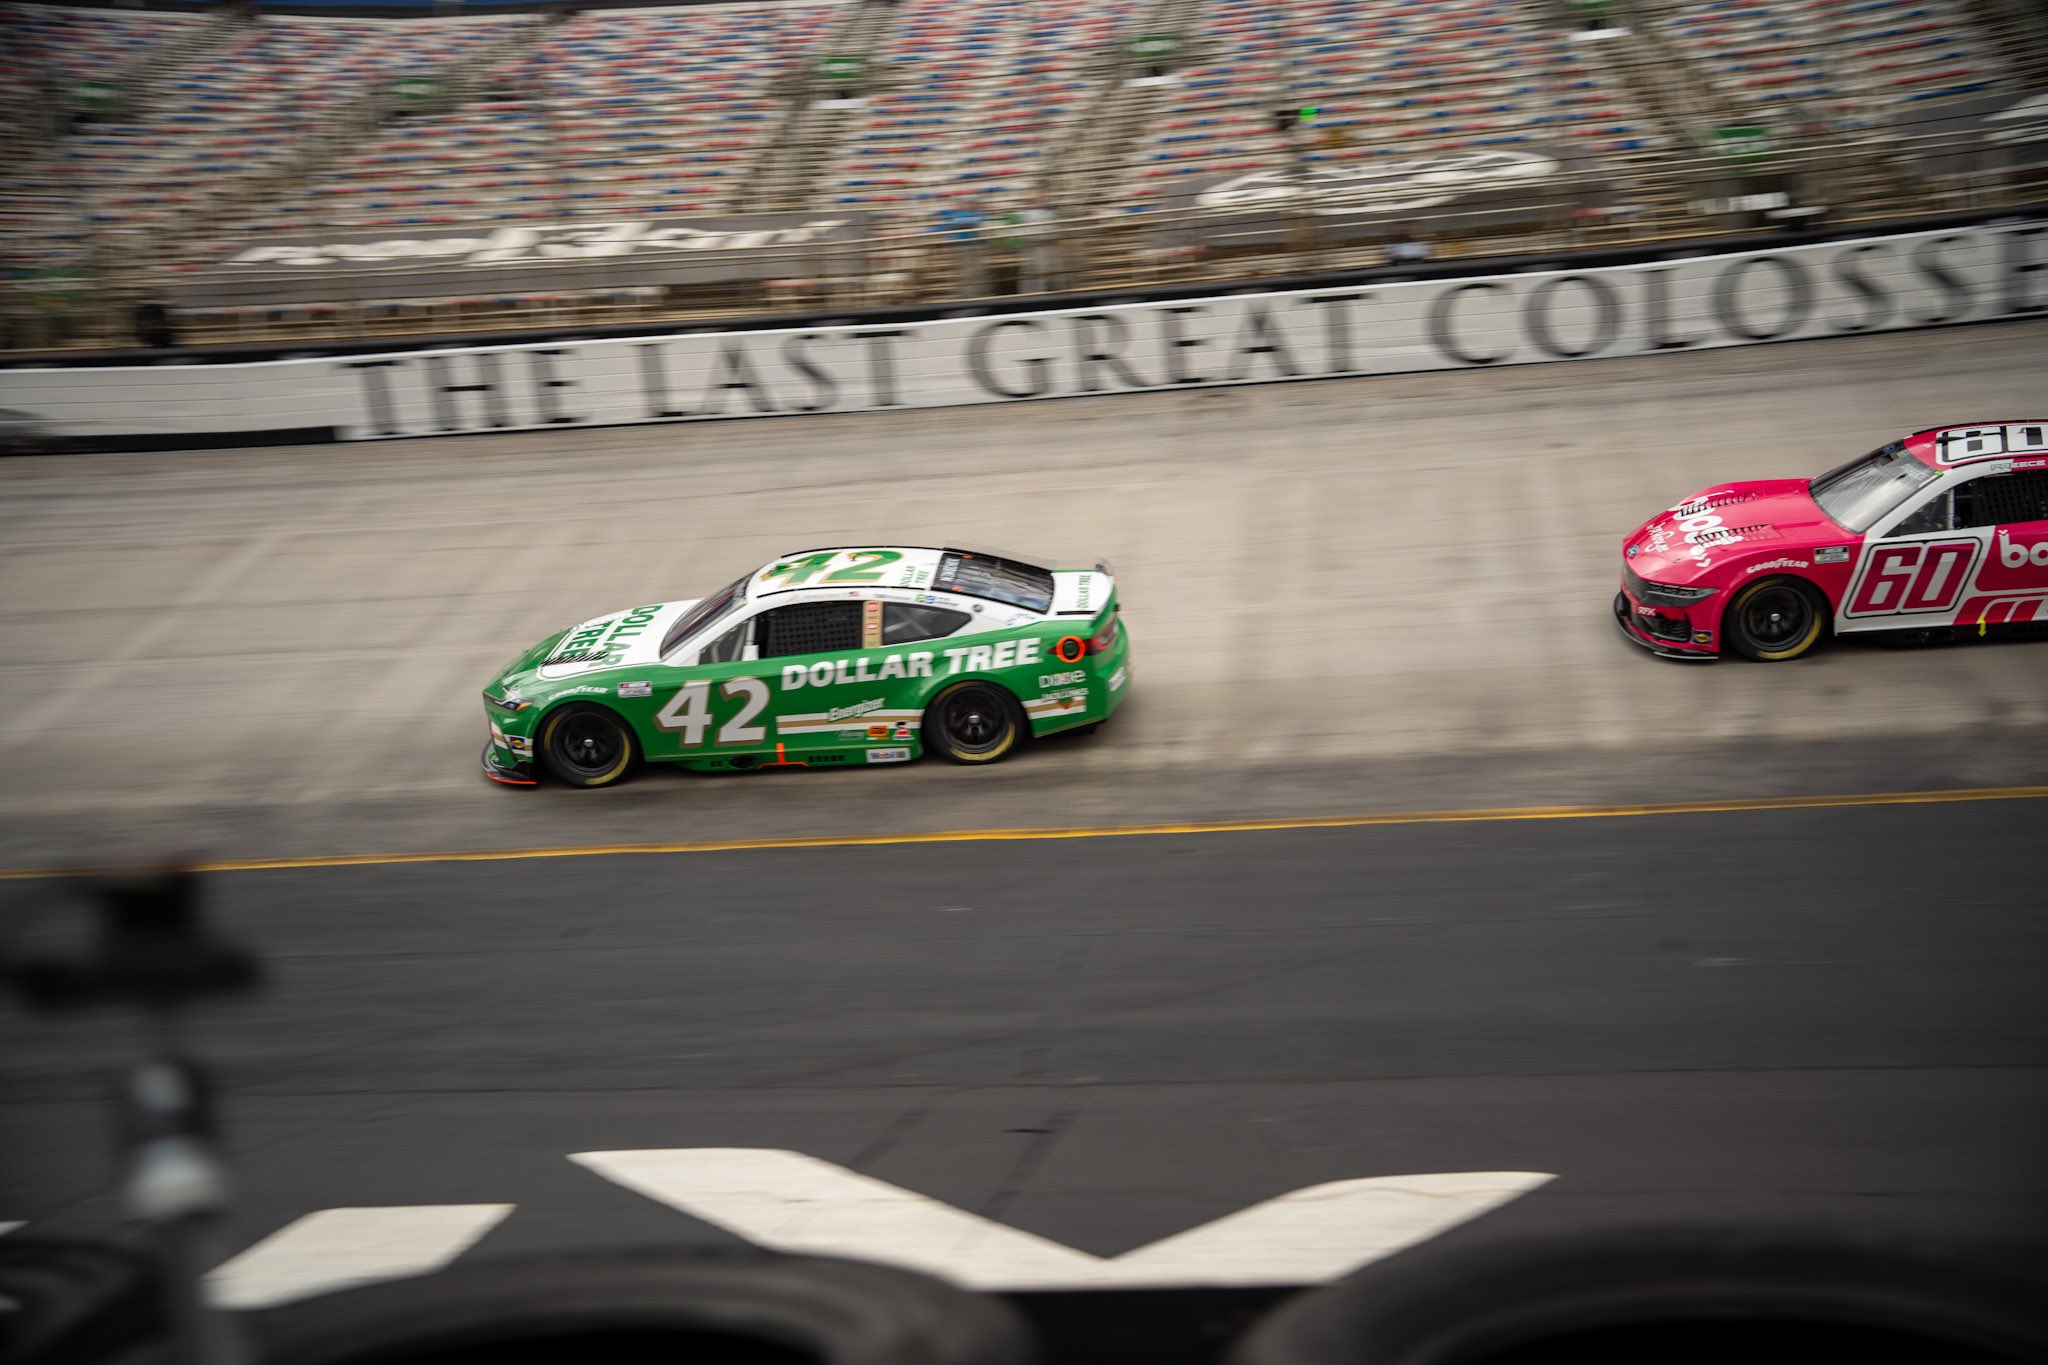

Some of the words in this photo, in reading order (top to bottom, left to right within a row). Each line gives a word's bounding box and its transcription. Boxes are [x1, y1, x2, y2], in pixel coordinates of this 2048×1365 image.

[342, 347, 588, 436] THE
[622, 330, 918, 418] LAST
[966, 292, 1384, 398] GREAT
[1427, 226, 2048, 364] COLOSSE
[761, 550, 904, 588] 42
[1850, 543, 1976, 613] 60
[781, 651, 935, 691] DOLLAR
[943, 637, 1042, 675] TREE
[653, 676, 771, 748] 42
